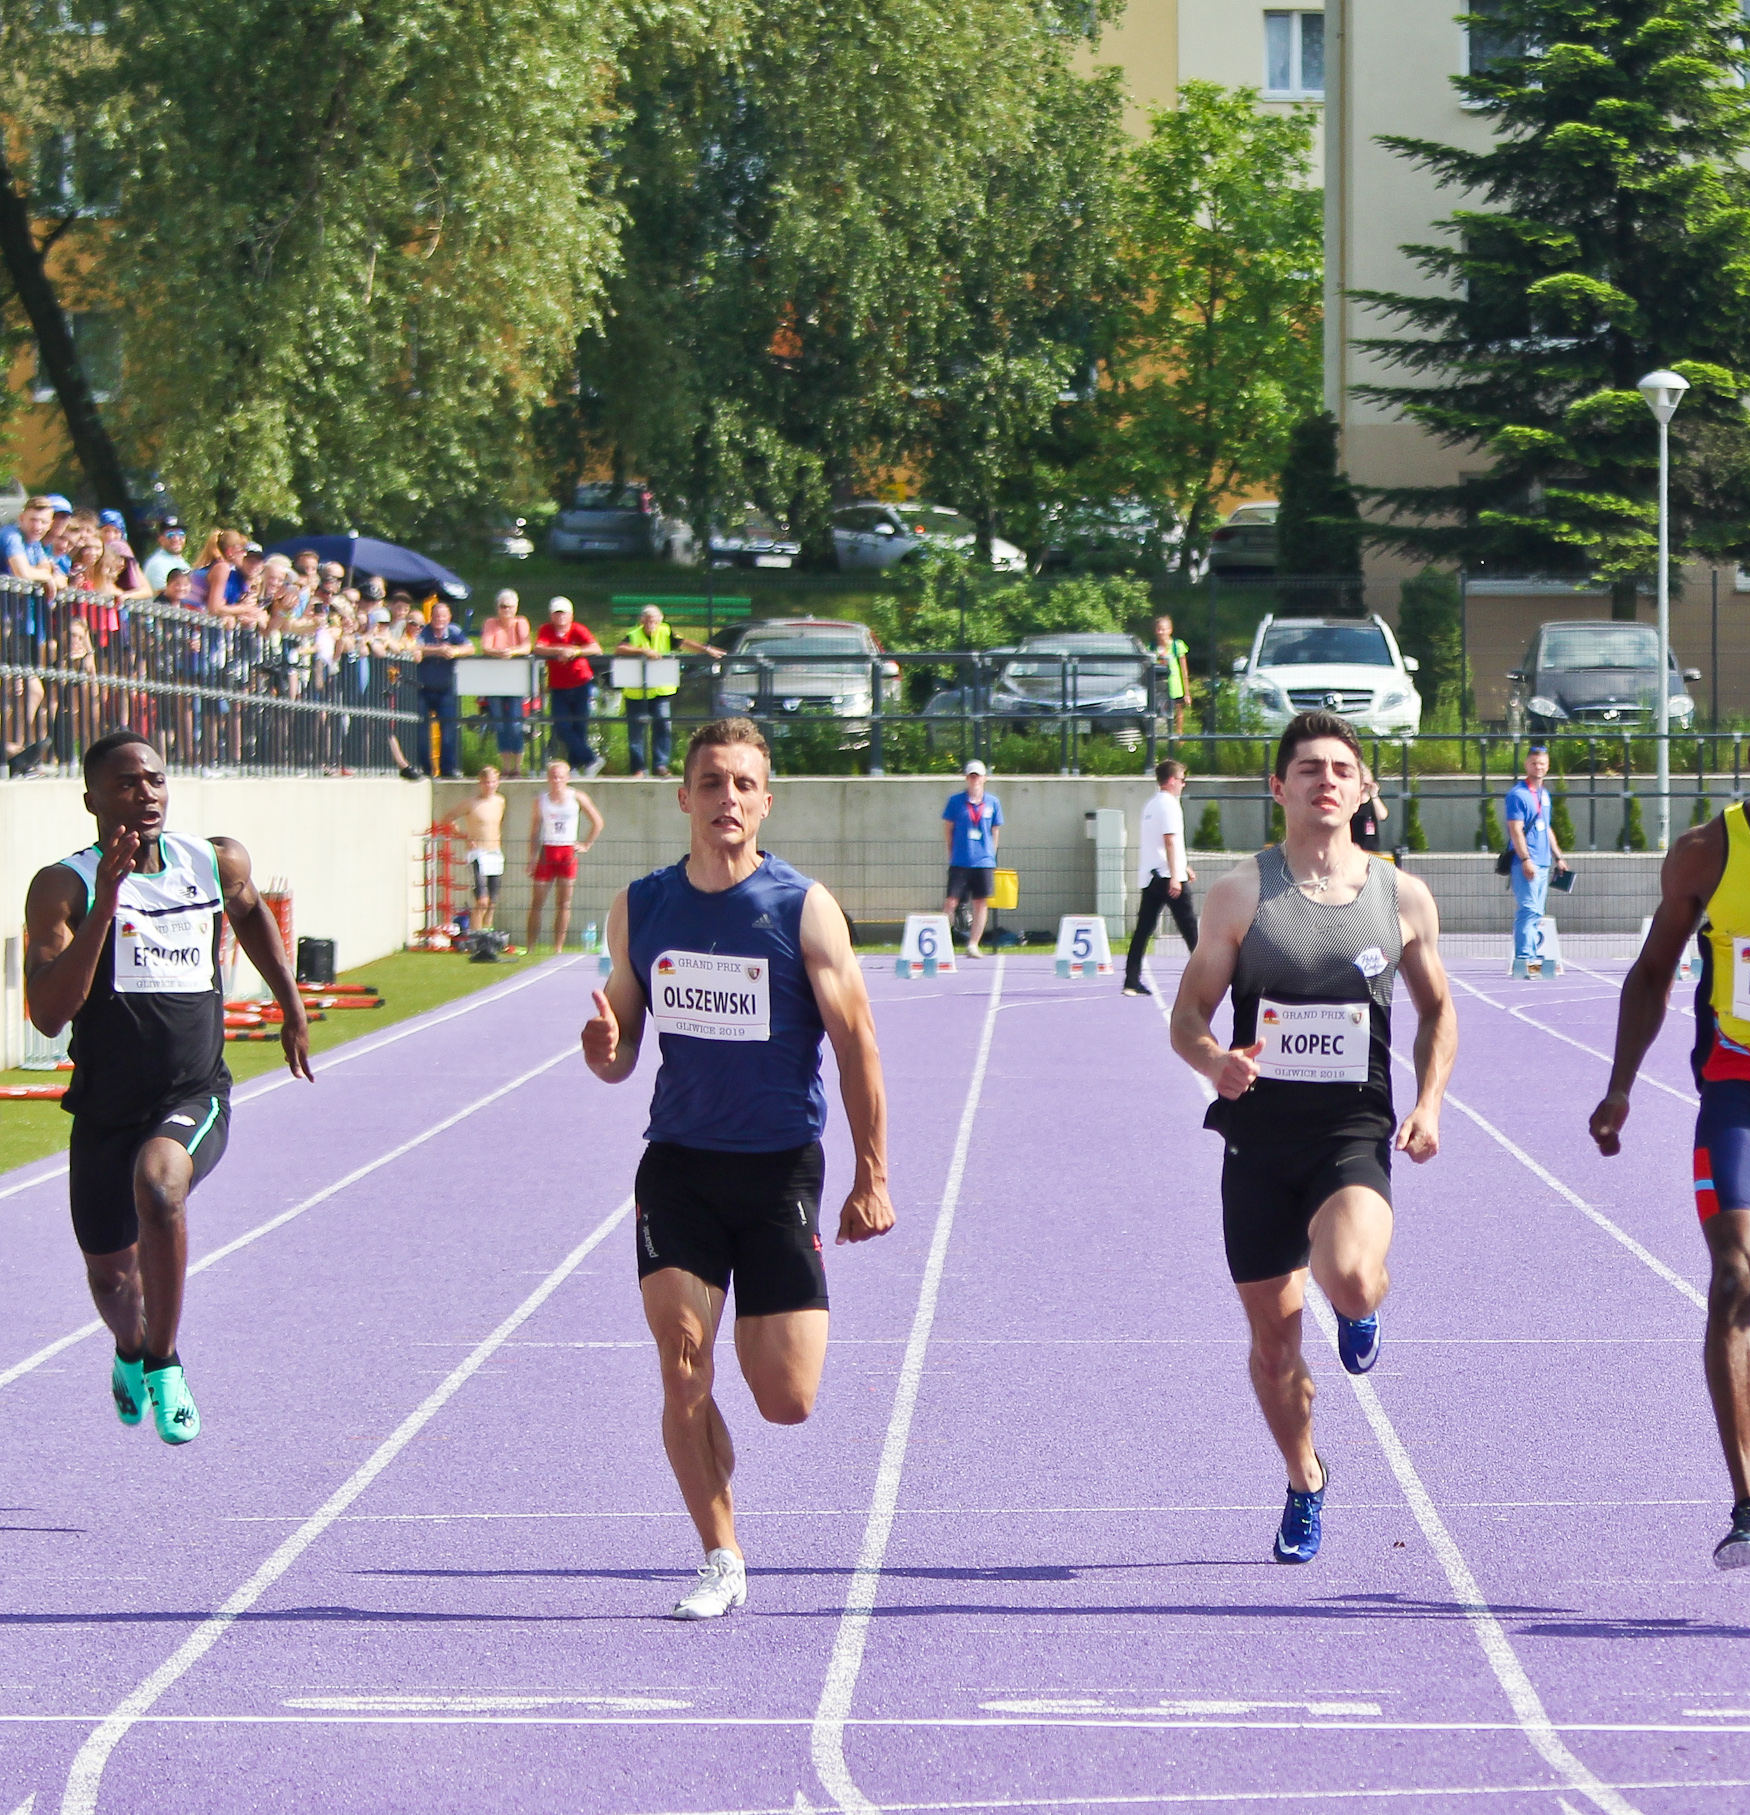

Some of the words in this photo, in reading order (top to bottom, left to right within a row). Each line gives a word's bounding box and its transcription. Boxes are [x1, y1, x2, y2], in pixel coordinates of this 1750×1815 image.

[918, 927, 938, 958] 6
[1072, 929, 1092, 959] 5
[678, 957, 714, 971] GRAND
[717, 961, 742, 973] PRIX
[664, 986, 756, 1015] OLSZEWSKI
[1282, 1010, 1317, 1020] GRAND
[1321, 1011, 1345, 1020] PRIX
[676, 1021, 716, 1034] GLIWICE
[719, 1027, 745, 1037] 2019
[1281, 1034, 1345, 1056] KOPEC
[1275, 1068, 1317, 1078] GLIWICE
[1320, 1070, 1345, 1079] 2019
[643, 1225, 660, 1258] polanik
